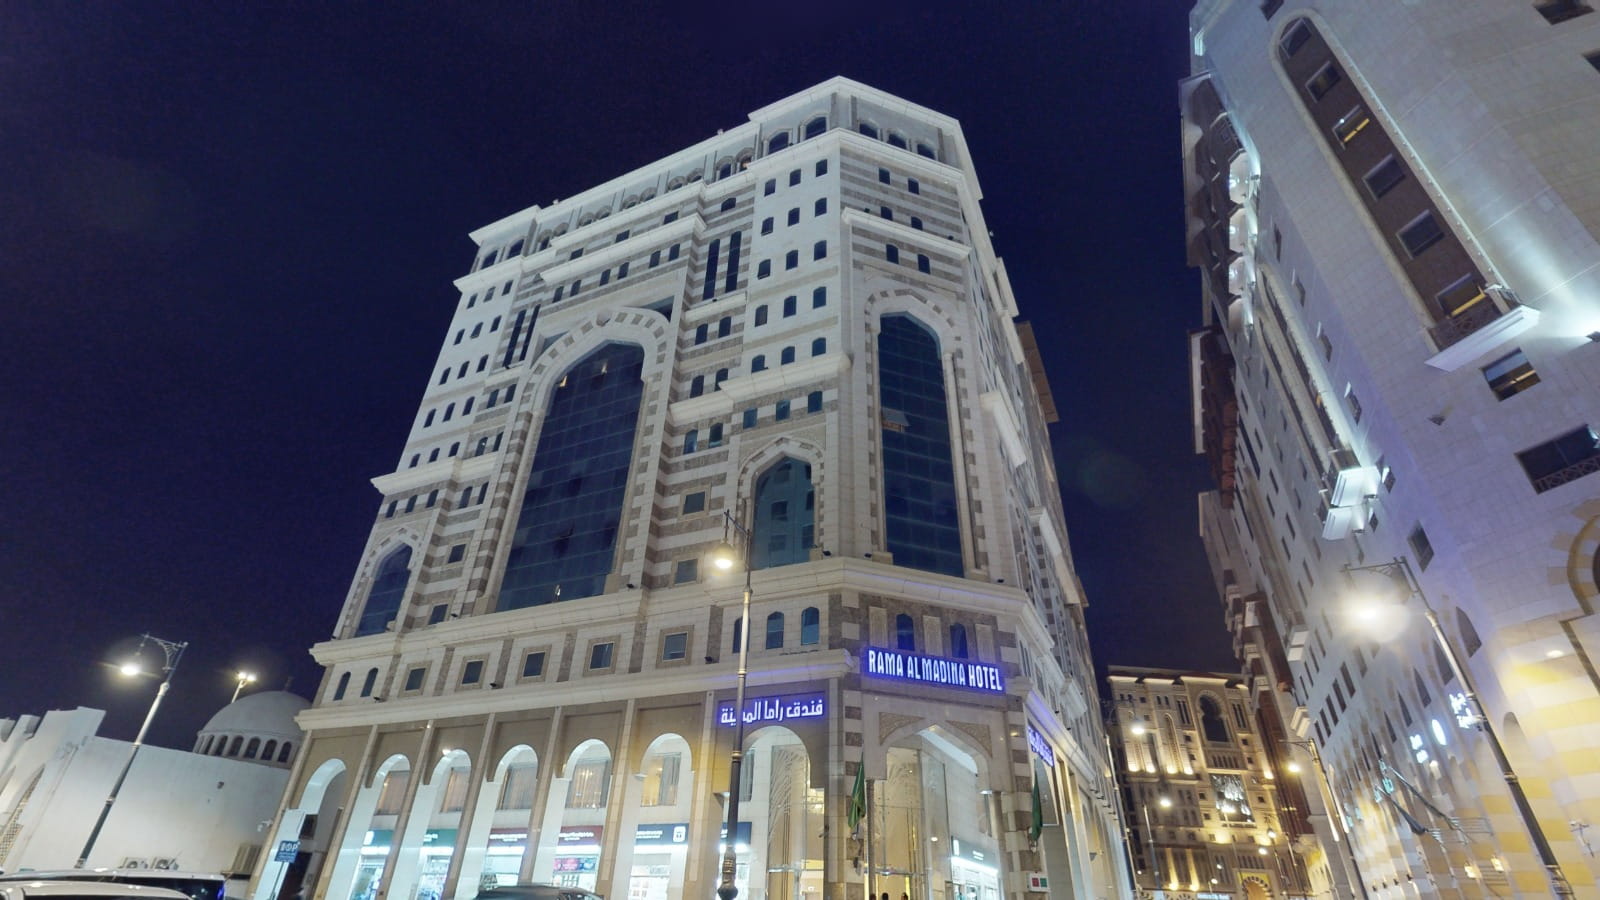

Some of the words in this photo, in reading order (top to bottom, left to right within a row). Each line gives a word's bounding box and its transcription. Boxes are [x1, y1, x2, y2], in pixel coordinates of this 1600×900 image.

[868, 650, 904, 677] RAMA
[968, 664, 1003, 691] HOTEL
[721, 701, 762, 726] المينة
[764, 699, 784, 722] راما
[786, 699, 823, 718] فندق
